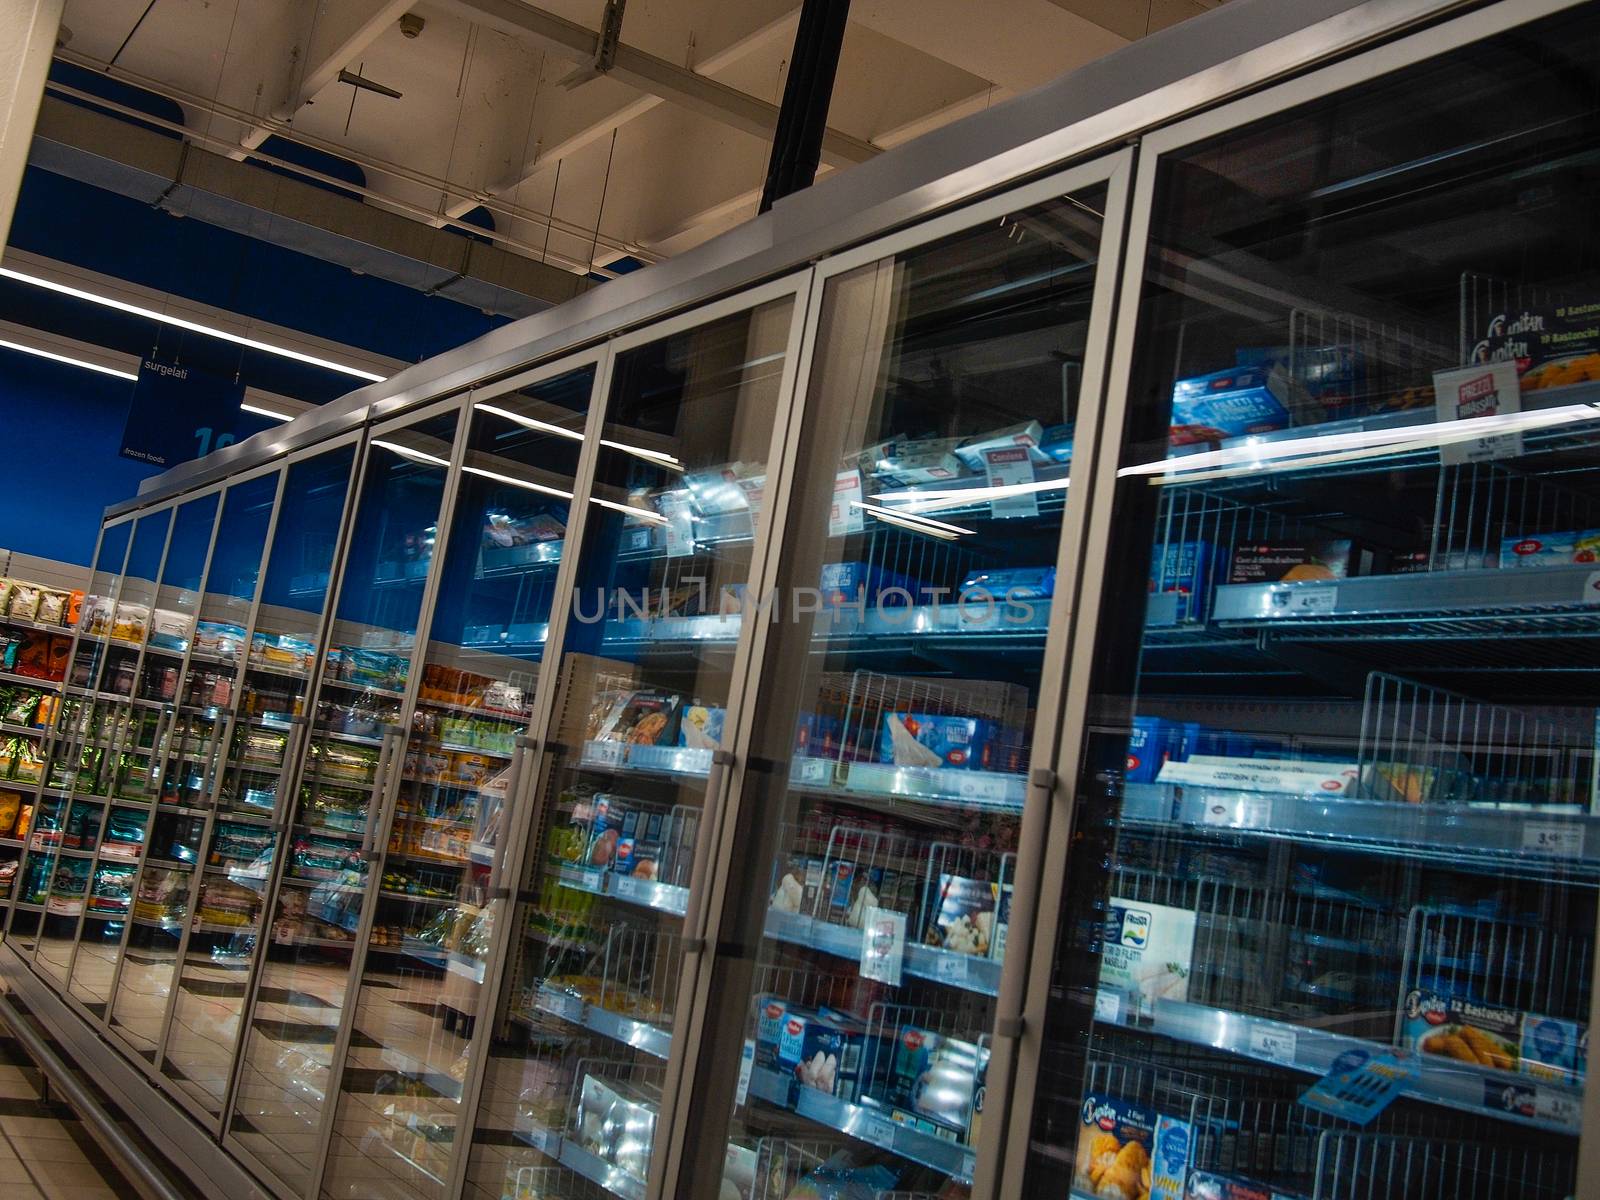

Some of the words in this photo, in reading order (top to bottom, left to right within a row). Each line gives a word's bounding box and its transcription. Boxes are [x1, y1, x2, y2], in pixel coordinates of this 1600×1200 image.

[144, 359, 189, 380] surgelati
[124, 446, 146, 460] frozen
[147, 451, 166, 464] foods
